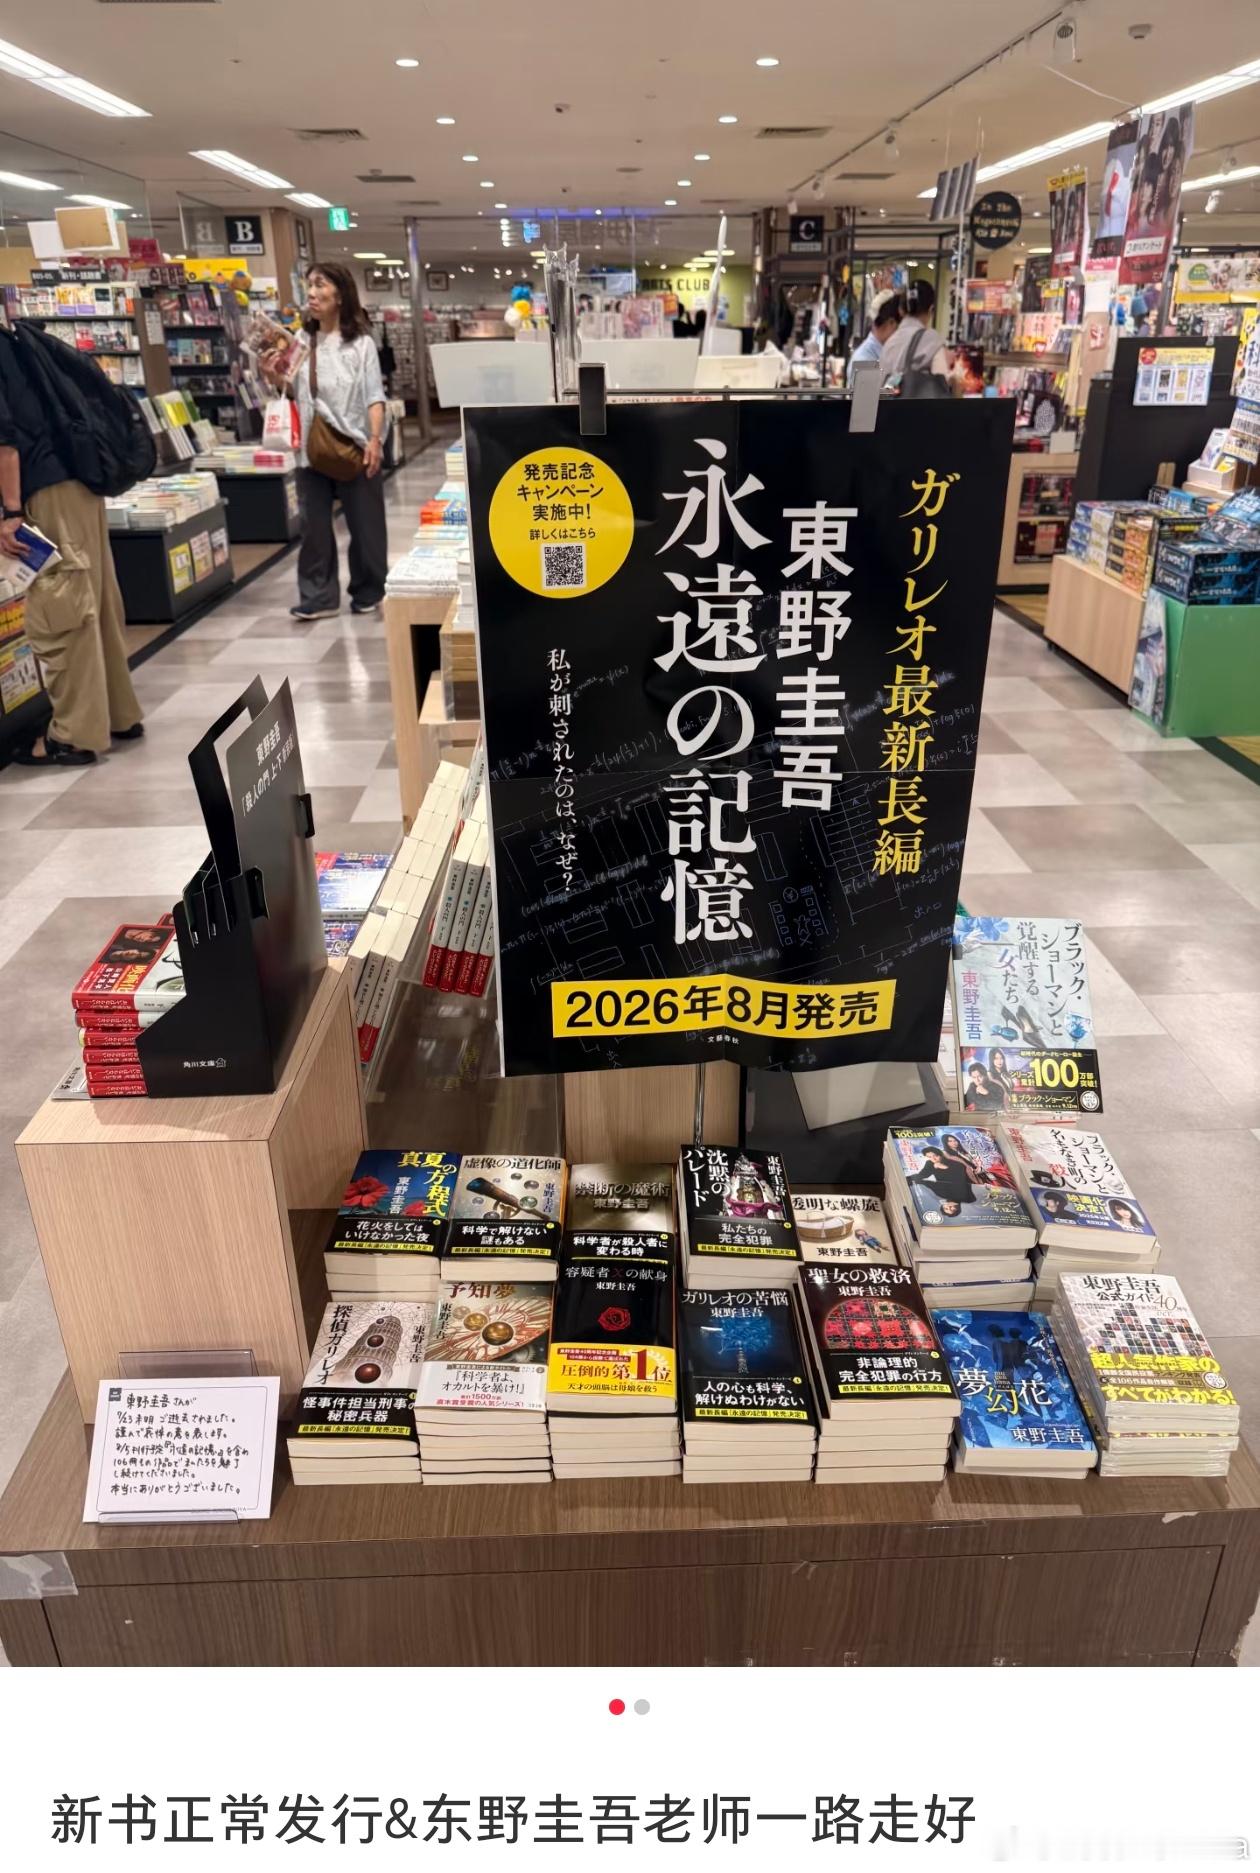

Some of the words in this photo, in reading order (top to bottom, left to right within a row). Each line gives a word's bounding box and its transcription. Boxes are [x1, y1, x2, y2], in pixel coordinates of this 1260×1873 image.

[235, 220, 254, 242] B
[800, 220, 815, 241] C
[677, 279, 710, 291] CLUB
[524, 461, 595, 481] 発売記念
[517, 483, 605, 501] キャンペーン
[532, 503, 592, 522] 実施中!
[529, 527, 597, 541] 詳しくはこちら
[774, 500, 859, 812] 東野圭吾
[873, 468, 961, 876] ガリレオ最新長編
[653, 438, 774, 946] 永遠の記憶
[547, 648, 579, 893] 私が刺されたのは、なぜ?
[1017, 922, 1040, 996] 覚醒する
[1064, 922, 1086, 1001] ブラック・
[995, 948, 1020, 1004] 女たち
[1041, 929, 1067, 1037] ショーマンと
[565, 982, 880, 1032] 2026年8月発売
[961, 970, 982, 1040] 東野圭吾
[1029, 1058, 1080, 1088] 100
[463, 1157, 561, 1171] 虚像の道化師
[706, 1149, 731, 1196] 沈黙の
[398, 1151, 458, 1217] 真夏の方程式
[684, 1146, 710, 1207] パレード
[389, 1176, 411, 1214] 東野圭吾
[575, 1181, 671, 1198] 禁断の魔術
[593, 1198, 650, 1210] 東野圭吾
[356, 1220, 423, 1232] 花火をしては
[462, 1225, 547, 1236] 科学で解けない
[721, 1223, 767, 1235] 私たちの
[345, 1230, 430, 1242] いけなかった夜
[480, 1235, 525, 1245] 謎もある
[573, 1236, 668, 1248] 科学者が殺人者に
[718, 1233, 773, 1246] 完全犯罪
[596, 1246, 645, 1256] 変わる時
[816, 1247, 868, 1257] 東野圭吾
[565, 1266, 668, 1283] 容疑者Xの献身
[808, 1268, 912, 1285] 聖女の救済
[445, 1284, 516, 1299] 予知夢
[596, 1282, 637, 1292] 東野圭吾
[838, 1285, 892, 1297] 東野圭吾
[1083, 1275, 1160, 1294] 東野圭吾
[682, 1291, 789, 1306] ガリレオの苦悩
[1096, 1292, 1154, 1303] 公式ガイド
[1153, 1294, 1177, 1310] 40
[710, 1306, 764, 1318] 東野圭吾
[435, 1303, 452, 1340] 東野圭吾
[315, 1304, 353, 1385] 探偵ガリレオ
[409, 1325, 426, 1363] 東野圭吾
[856, 1356, 918, 1369] 非論理的
[1090, 1352, 1221, 1372] 超人気作家の
[838, 1368, 942, 1383] 完全犯罪の行方
[703, 1380, 792, 1394] 人の心も科学、
[953, 1368, 1053, 1415] 夢幻花
[1101, 1384, 1237, 1405] すべてがわかる!
[126, 1392, 197, 1408] 東野圭吾さんが
[303, 1396, 415, 1410] 怪事件担当刑事の
[694, 1393, 805, 1407] 解けぬわけがない
[327, 1410, 388, 1423] 秘密兵器
[1009, 1426, 1085, 1444] 東野圭吾
